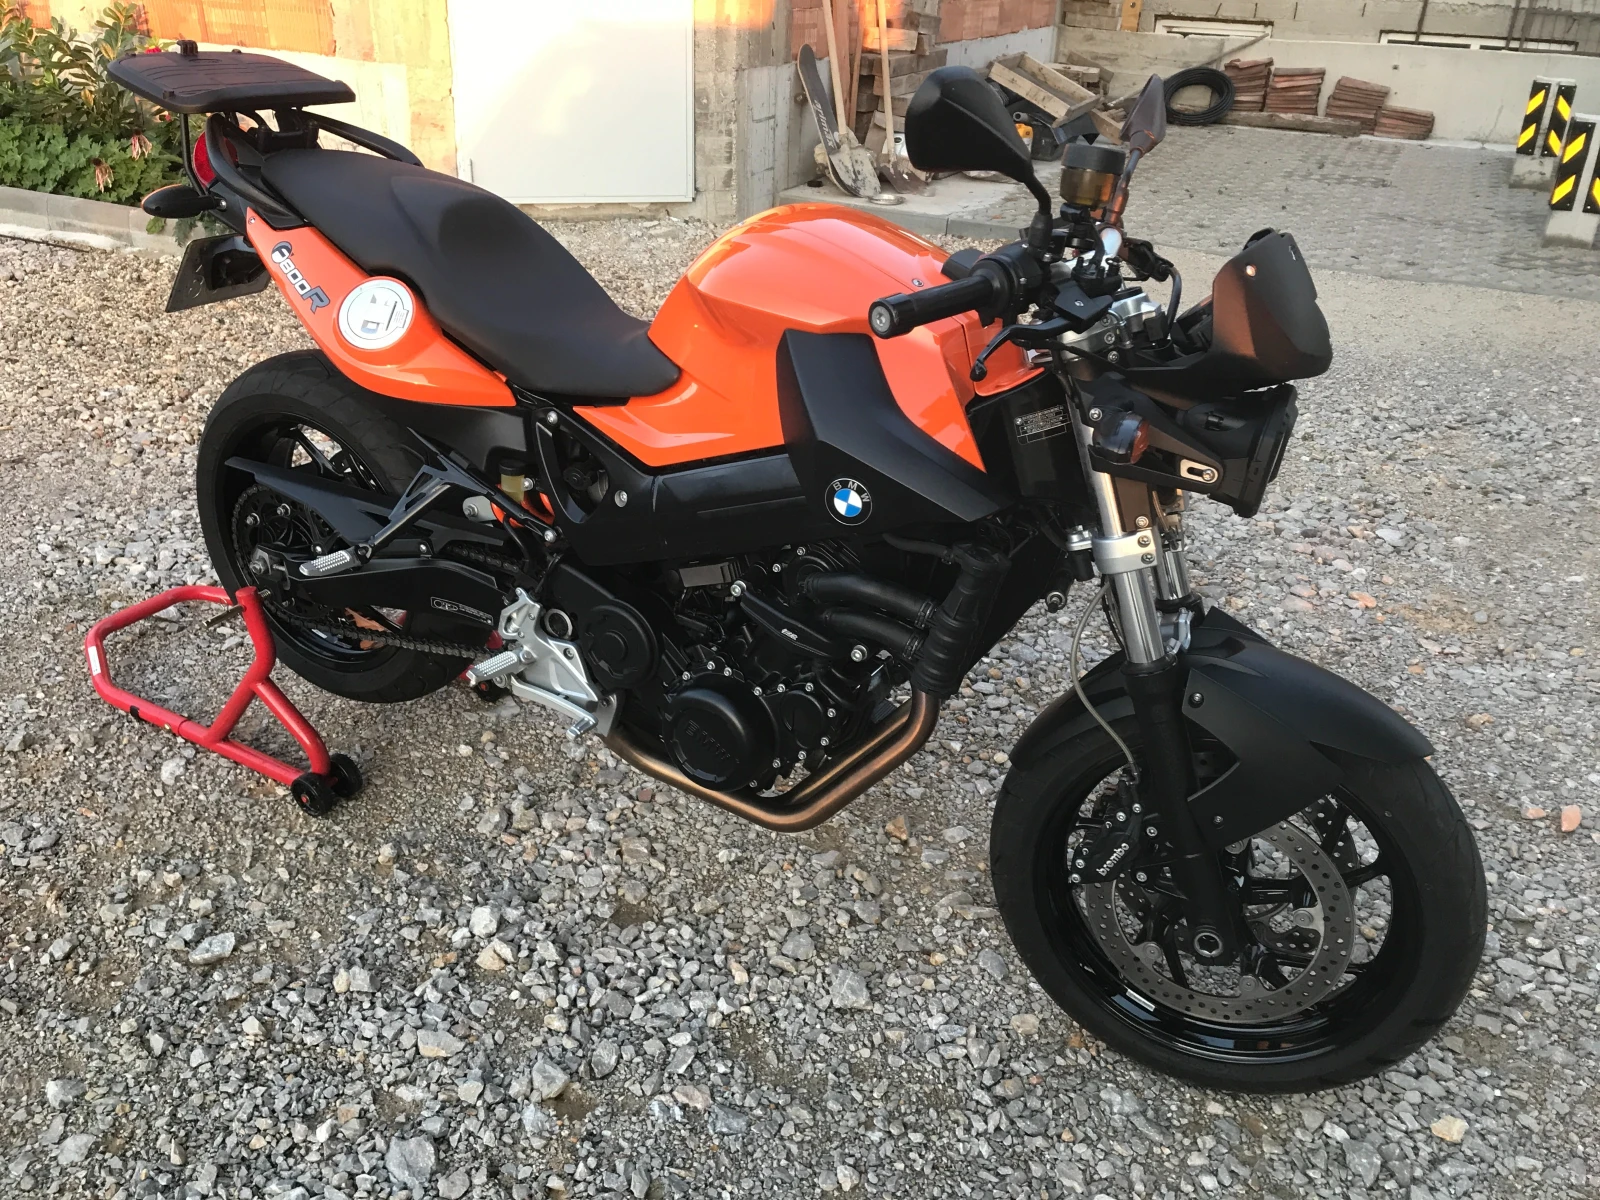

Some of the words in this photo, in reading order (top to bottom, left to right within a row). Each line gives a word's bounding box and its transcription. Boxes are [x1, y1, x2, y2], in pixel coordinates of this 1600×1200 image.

[271, 241, 331, 315] F800R
[832, 480, 870, 502] BMW
[685, 719, 732, 760] BMW
[1095, 842, 1130, 877] brembo
